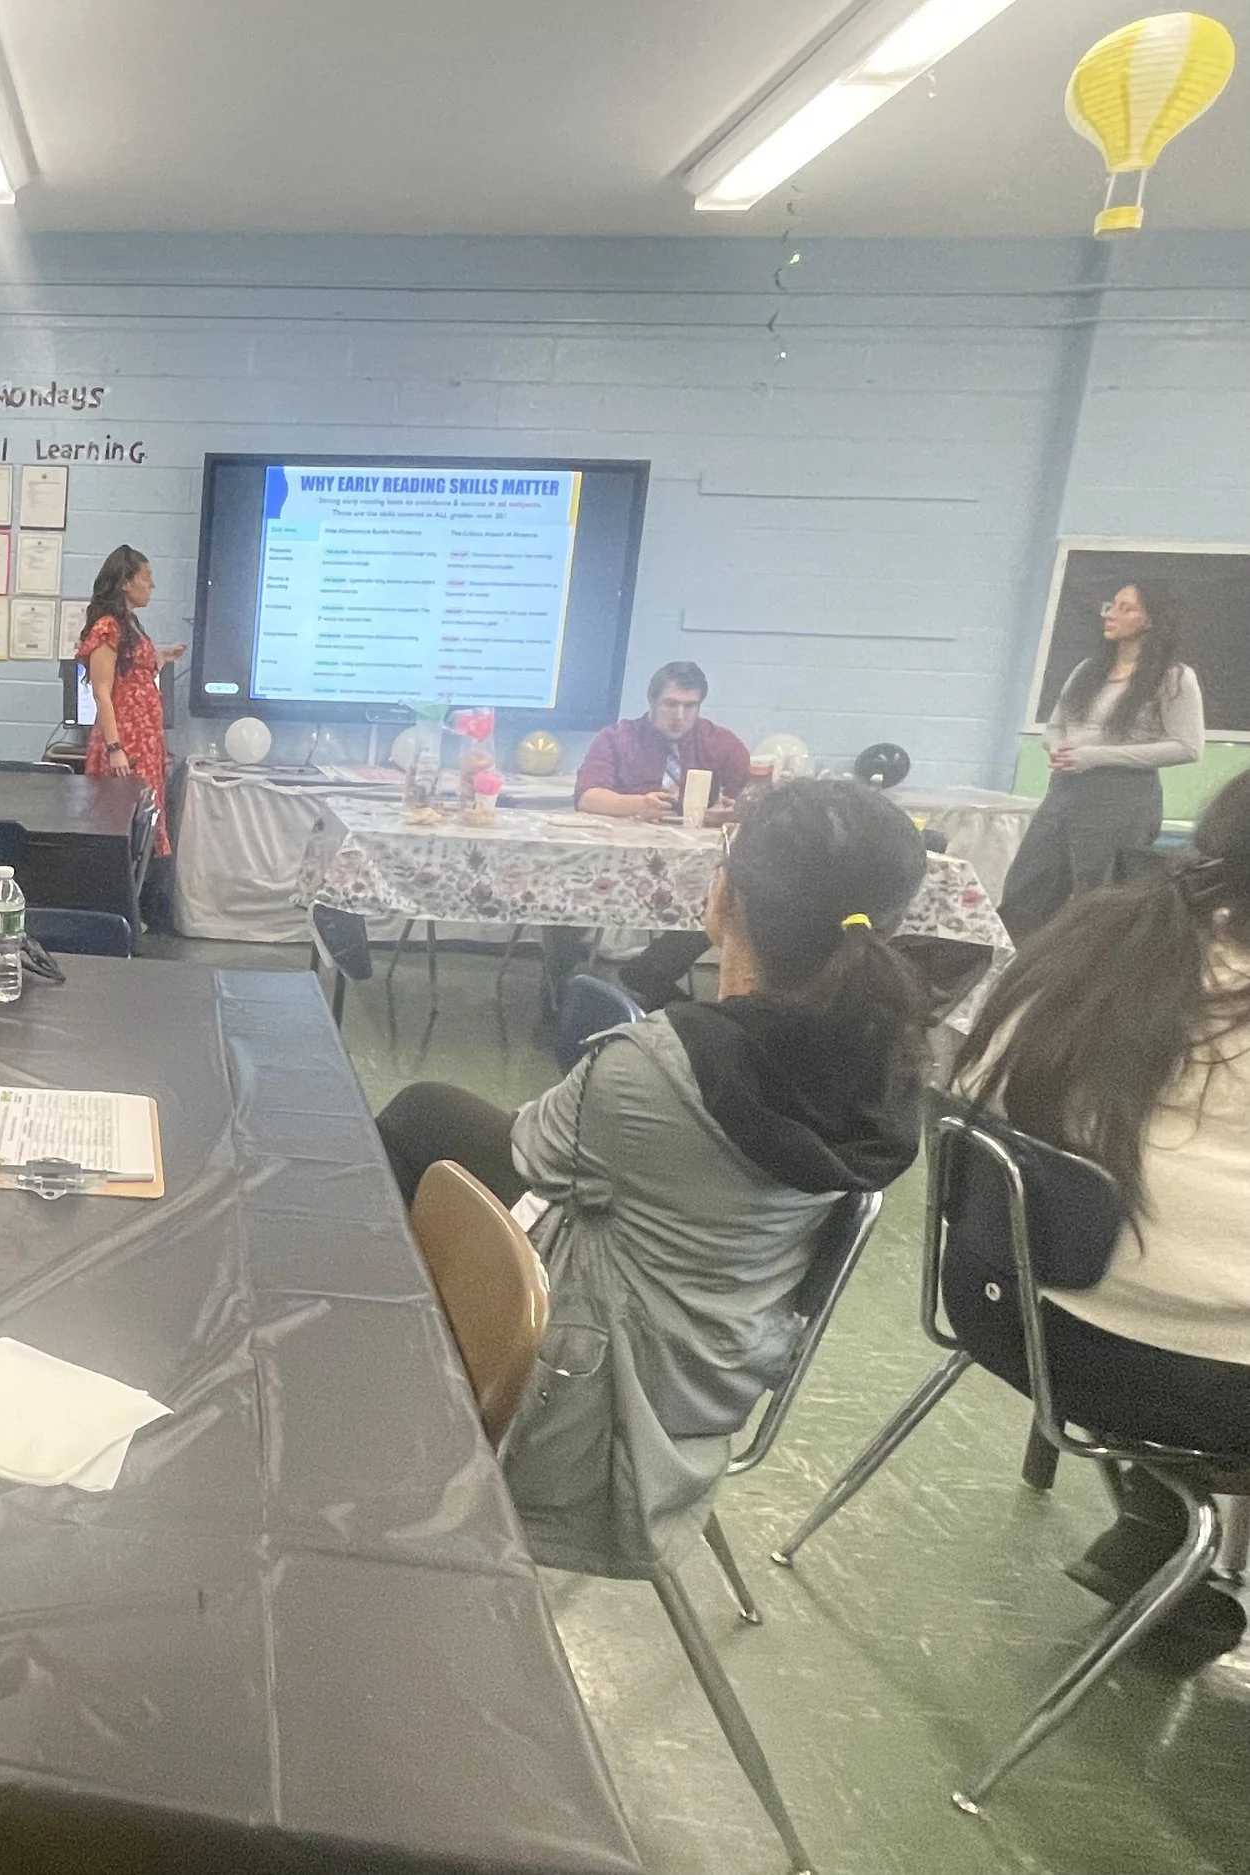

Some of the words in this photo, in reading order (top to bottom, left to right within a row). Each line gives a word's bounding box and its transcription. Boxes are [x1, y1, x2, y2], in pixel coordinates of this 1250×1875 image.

[301, 475, 335, 492] WHY
[338, 476, 380, 493] EARLY
[382, 476, 446, 494] READING
[450, 478, 499, 495] SKILLS
[501, 479, 560, 496] MATTER
